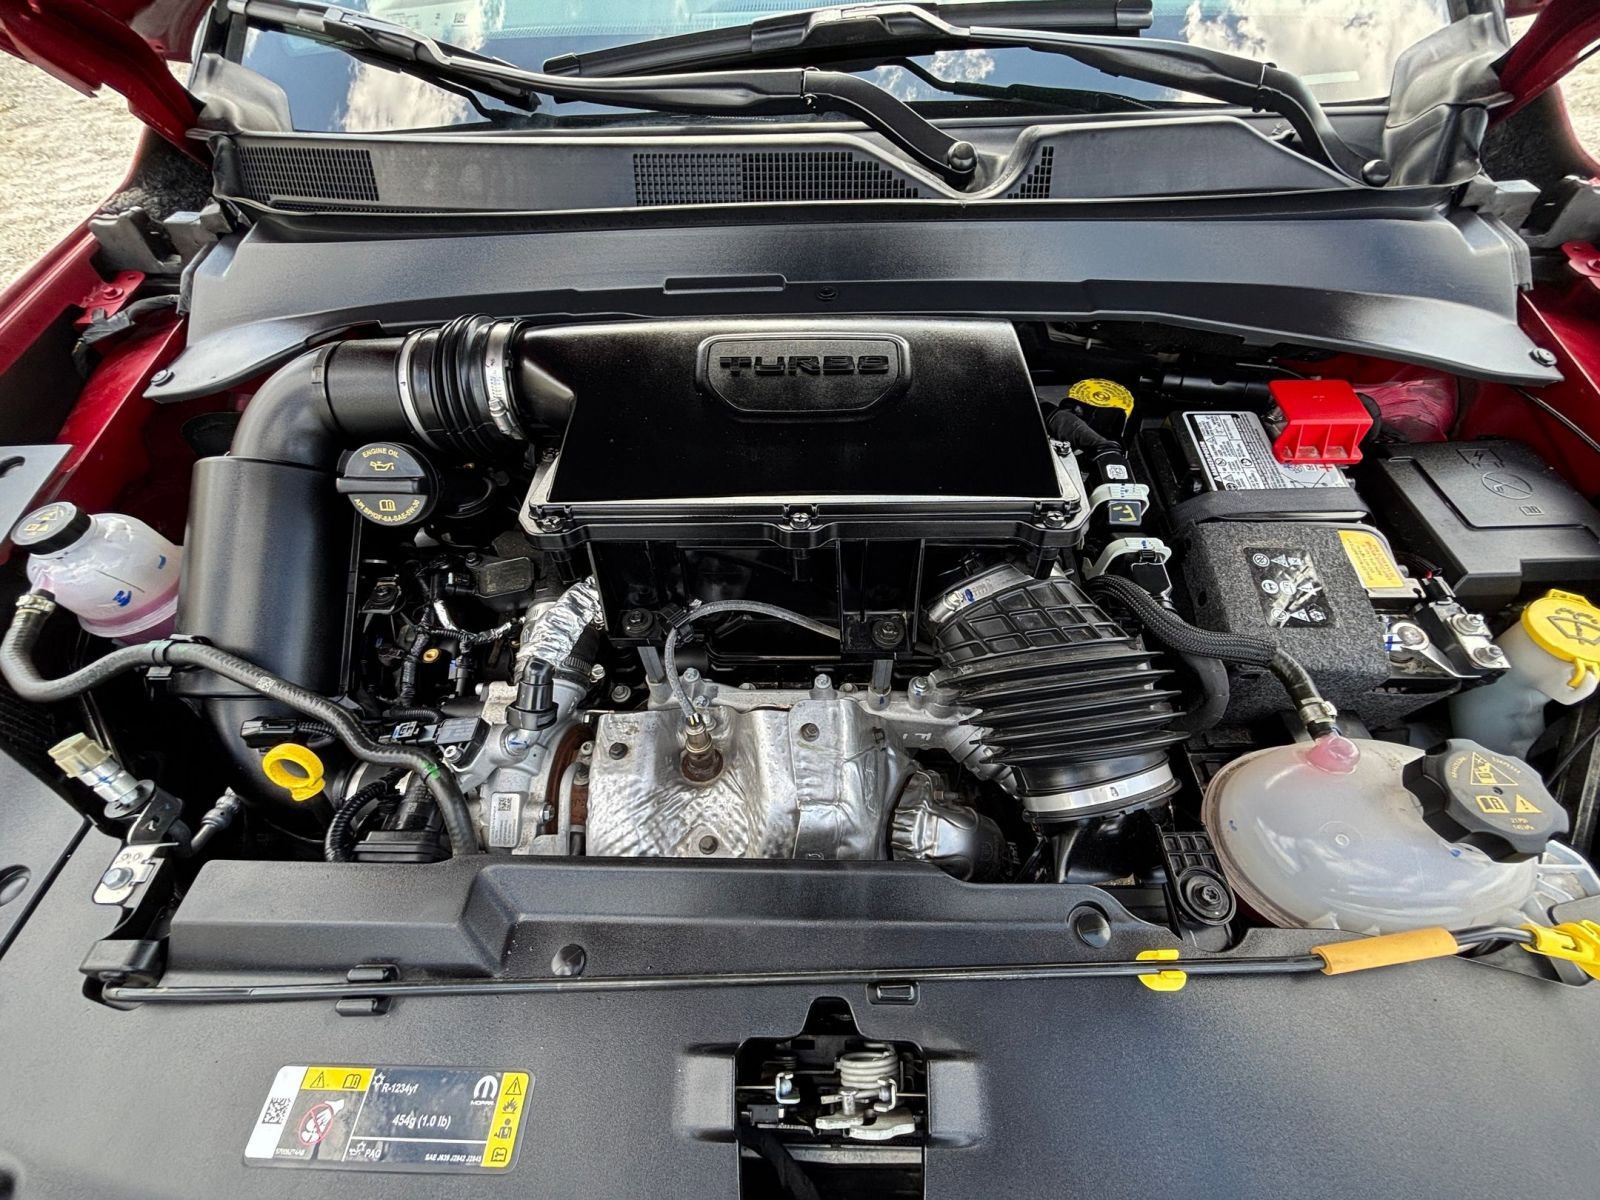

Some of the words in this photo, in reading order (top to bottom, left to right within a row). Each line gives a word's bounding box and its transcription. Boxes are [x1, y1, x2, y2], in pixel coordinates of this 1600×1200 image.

[362, 447, 387, 458] ENGINE
[388, 449, 400, 458] OIL
[354, 498, 365, 510] API
[381, 1082, 419, 1095] R-1234yf
[392, 1113, 416, 1129] 454g
[417, 1114, 436, 1129] (1.0
[437, 1115, 452, 1130] lb)
[364, 1148, 382, 1159] PAG
[425, 1153, 437, 1161] SAE
